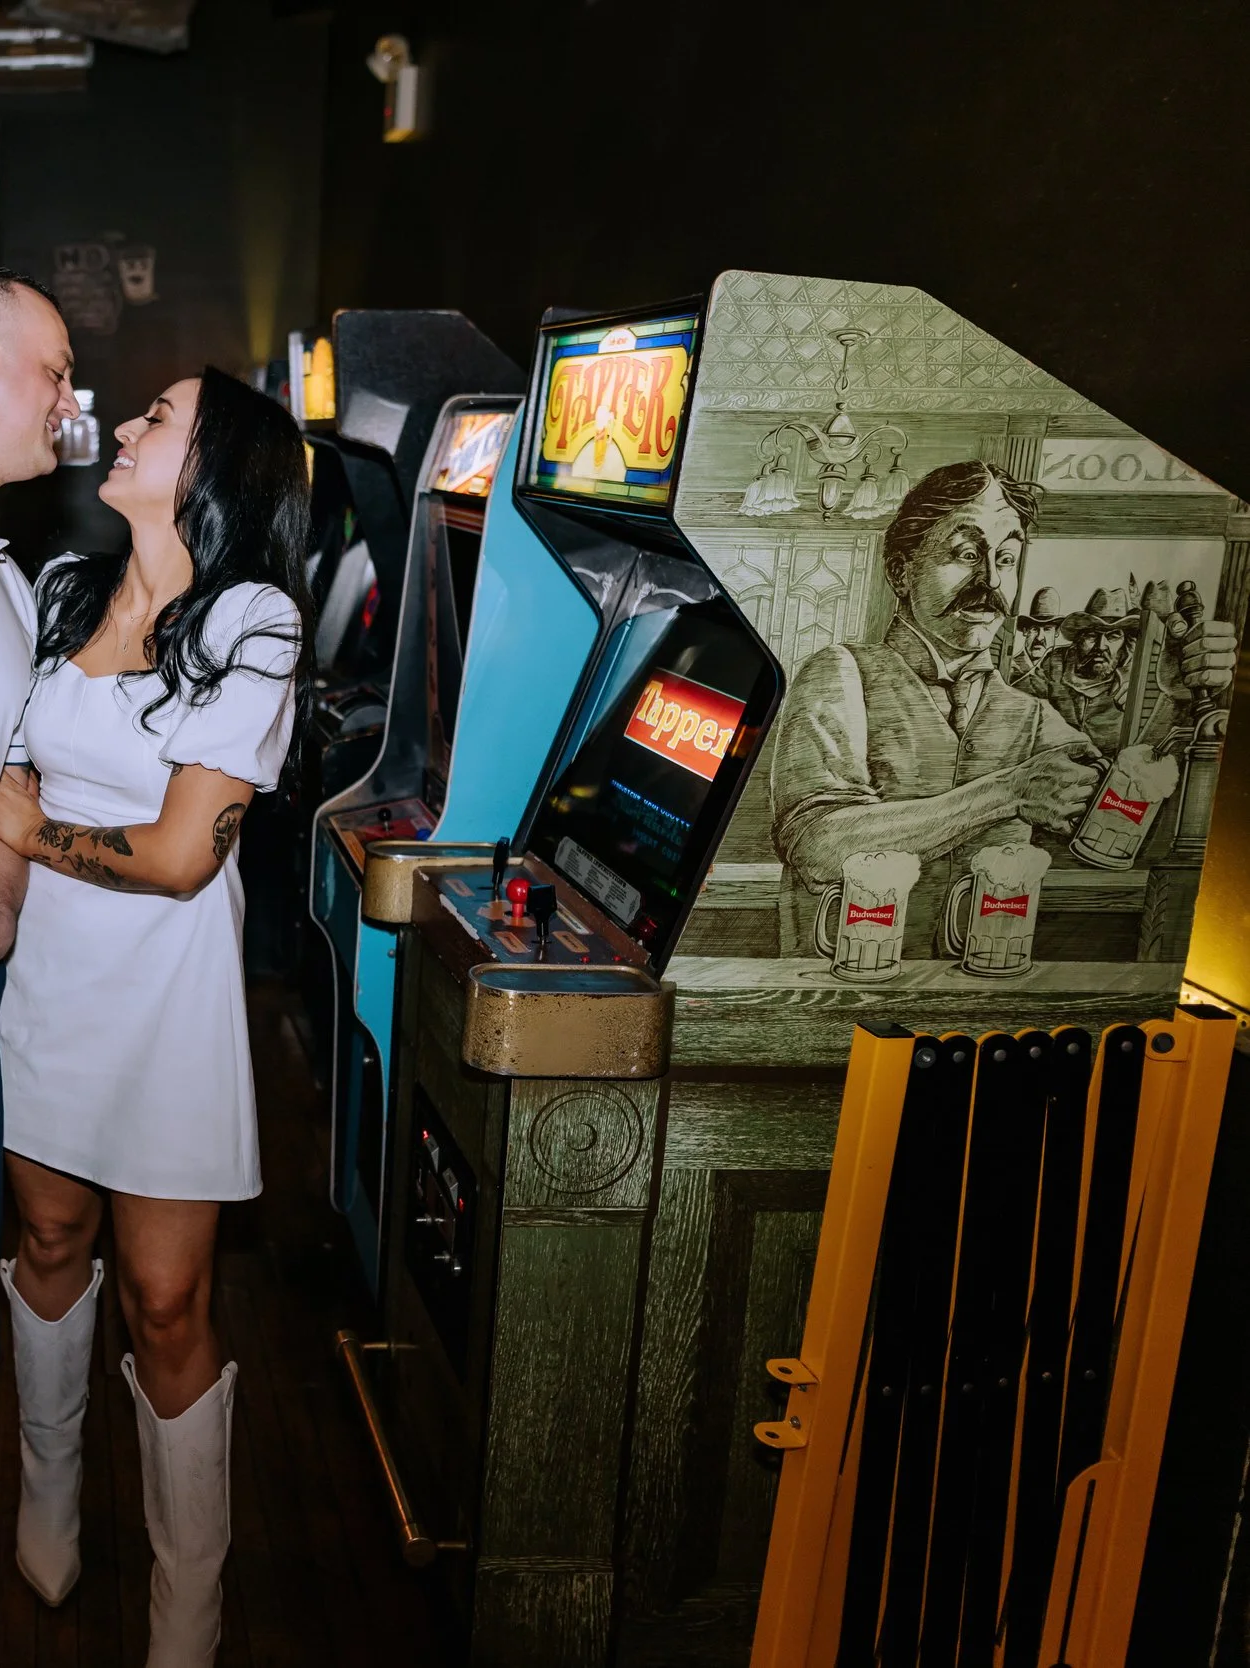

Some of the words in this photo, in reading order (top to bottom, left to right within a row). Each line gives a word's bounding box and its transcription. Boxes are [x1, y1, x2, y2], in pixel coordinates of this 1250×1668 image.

[550, 356, 677, 457] TAPPER
[636, 680, 735, 760] Tapper
[1103, 795, 1144, 816] Budweiser
[850, 910, 893, 919] Budweiser
[983, 901, 1027, 910] Budweiser
